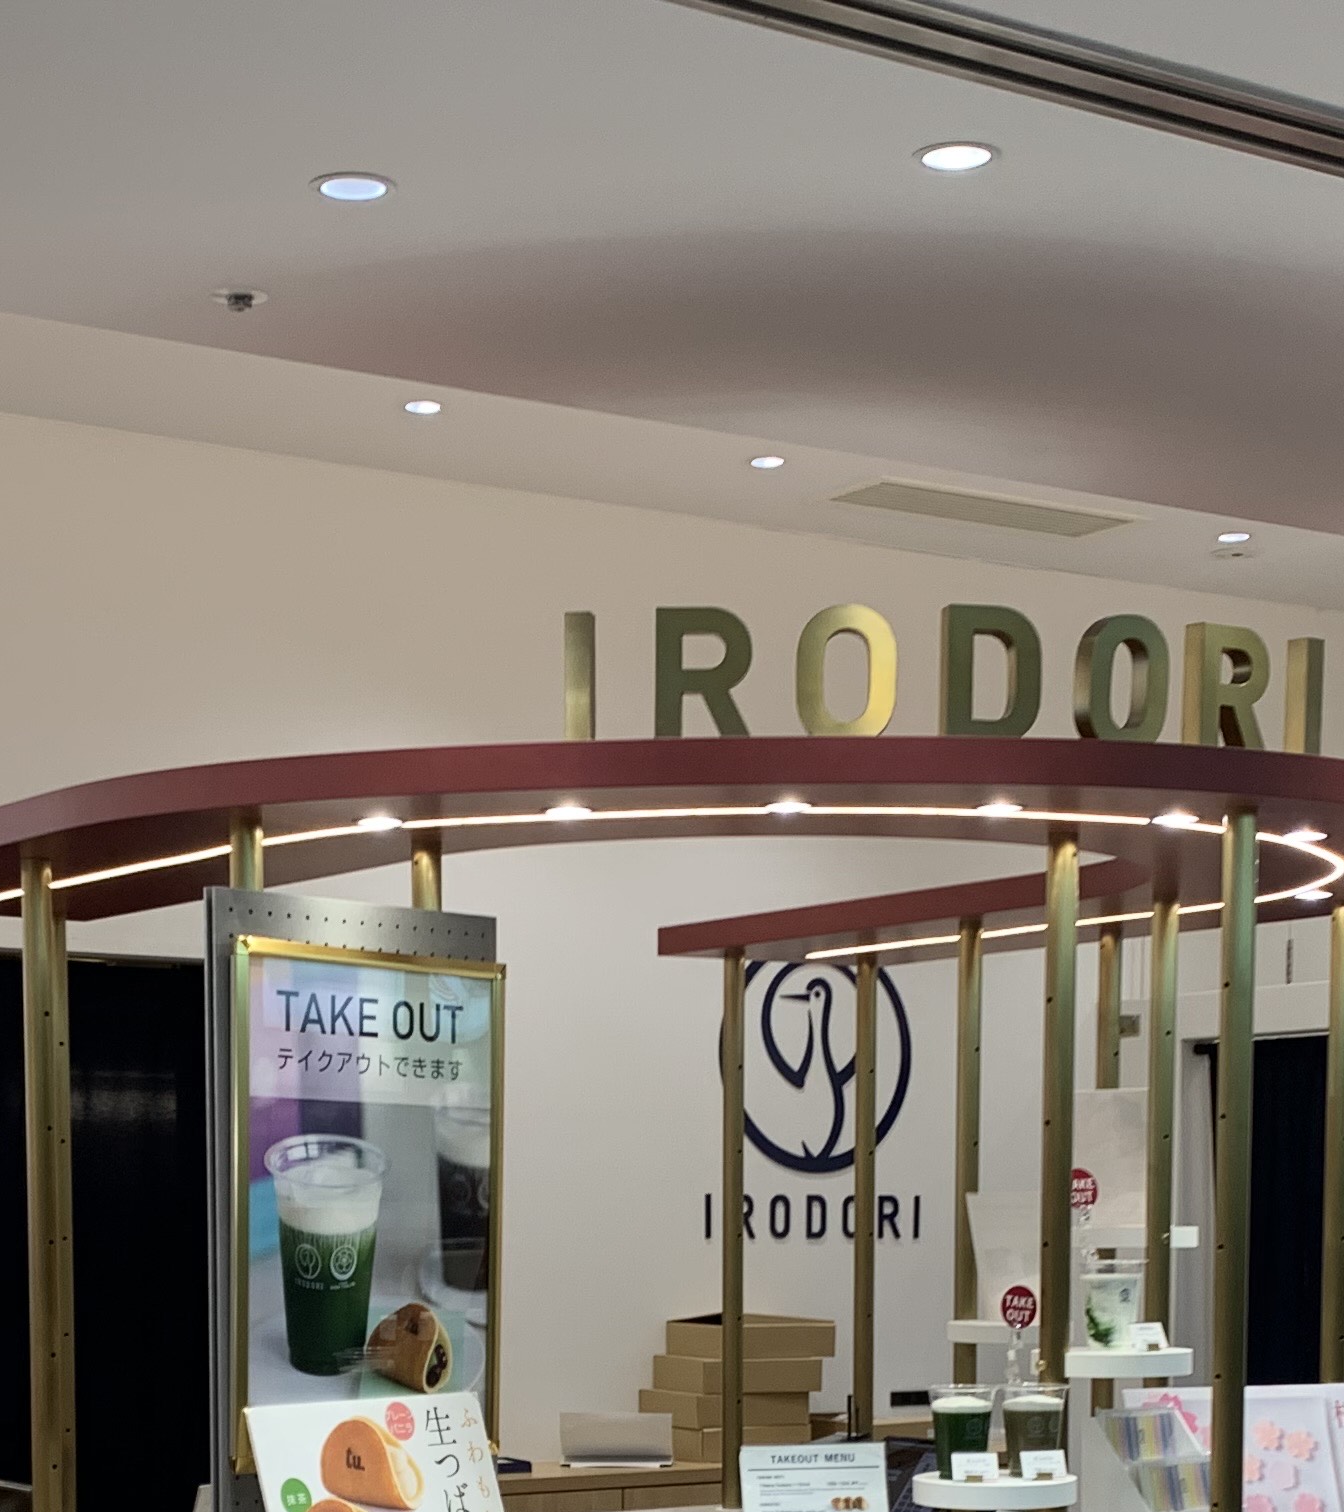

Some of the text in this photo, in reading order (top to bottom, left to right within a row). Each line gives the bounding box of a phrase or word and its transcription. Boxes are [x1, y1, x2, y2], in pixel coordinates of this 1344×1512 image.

[563, 603, 1325, 755] IRODORI
[275, 989, 464, 1045] TAKE OUT
[277, 1047, 464, 1081] テイクアウトできます
[1071, 1177, 1096, 1191] AKE
[704, 1193, 921, 1240] IRODORI
[1006, 1294, 1035, 1310] TAKE
[1006, 1309, 1032, 1323] OUT
[770, 1453, 856, 1464] TAKEOUT MENU
